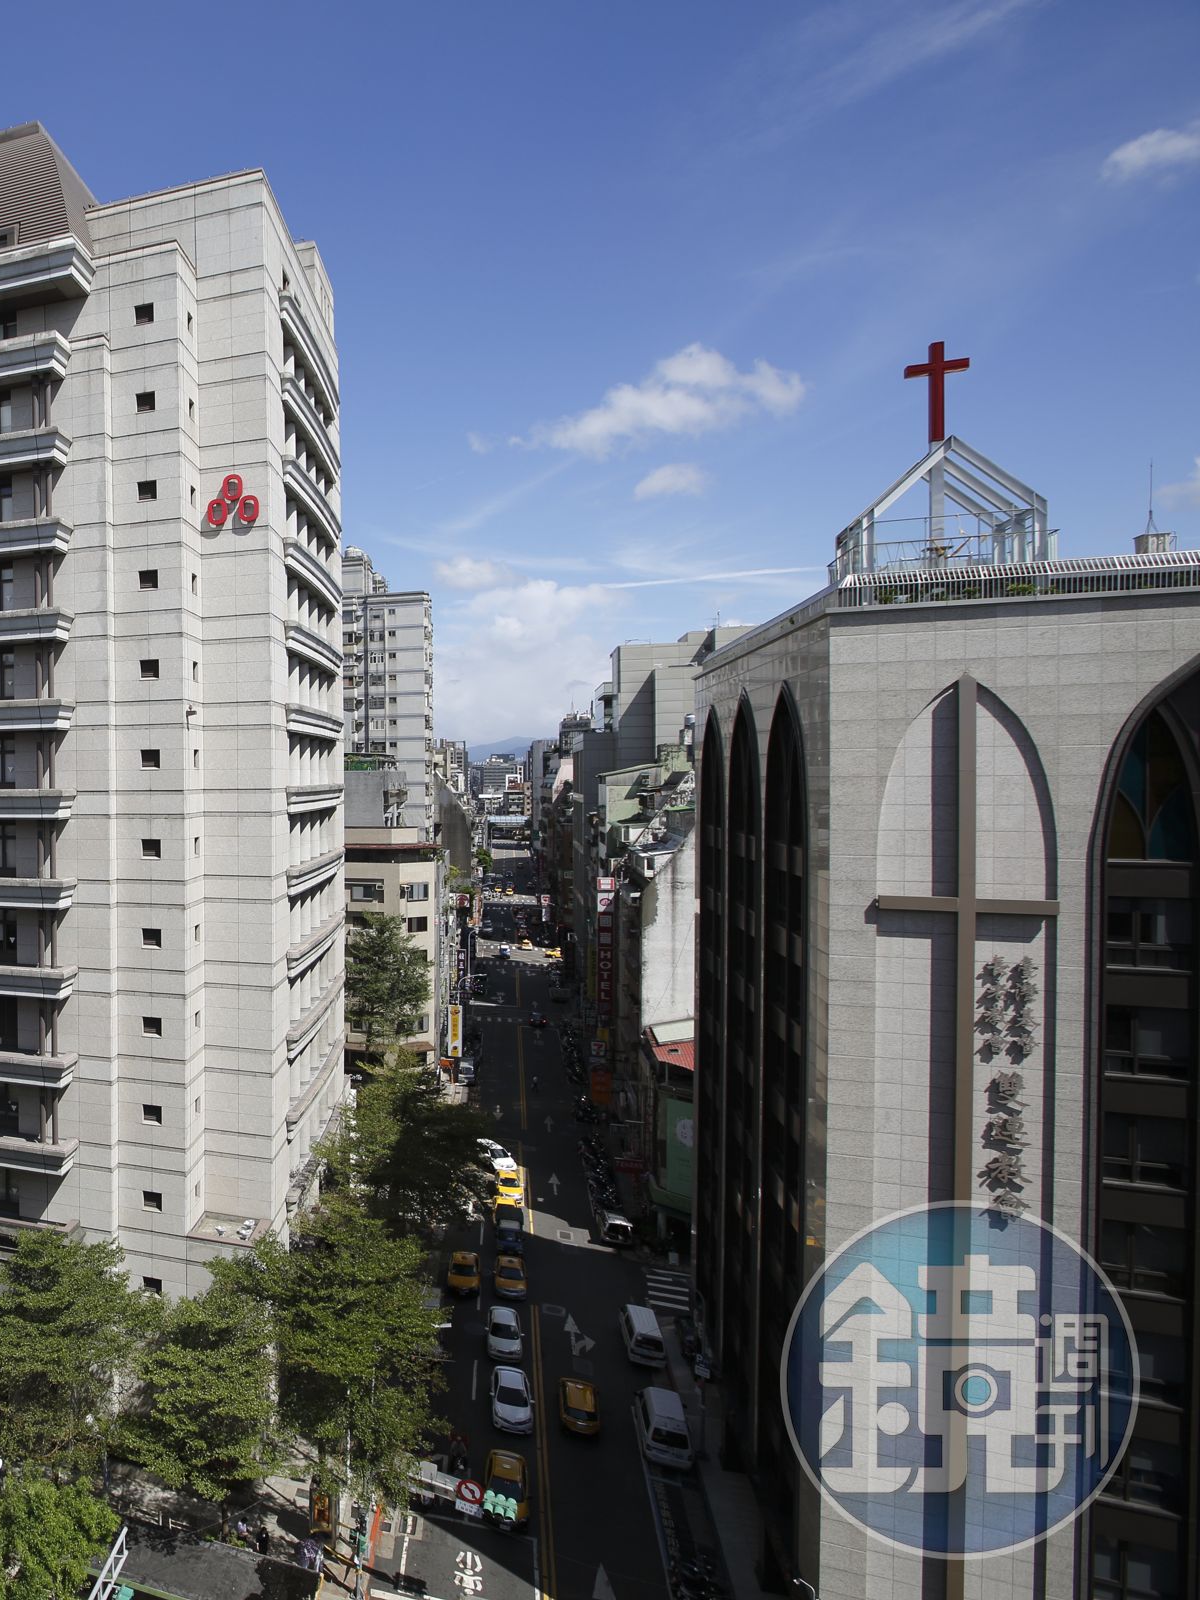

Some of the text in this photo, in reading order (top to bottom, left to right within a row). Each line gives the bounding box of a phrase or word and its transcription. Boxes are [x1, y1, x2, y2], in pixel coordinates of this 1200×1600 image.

[599, 950, 612, 1001] HOTEL
[982, 954, 1010, 1057] 長老教會
[1015, 955, 1040, 1059] 臺灣基督
[986, 1069, 1034, 1221] 雙連教會
